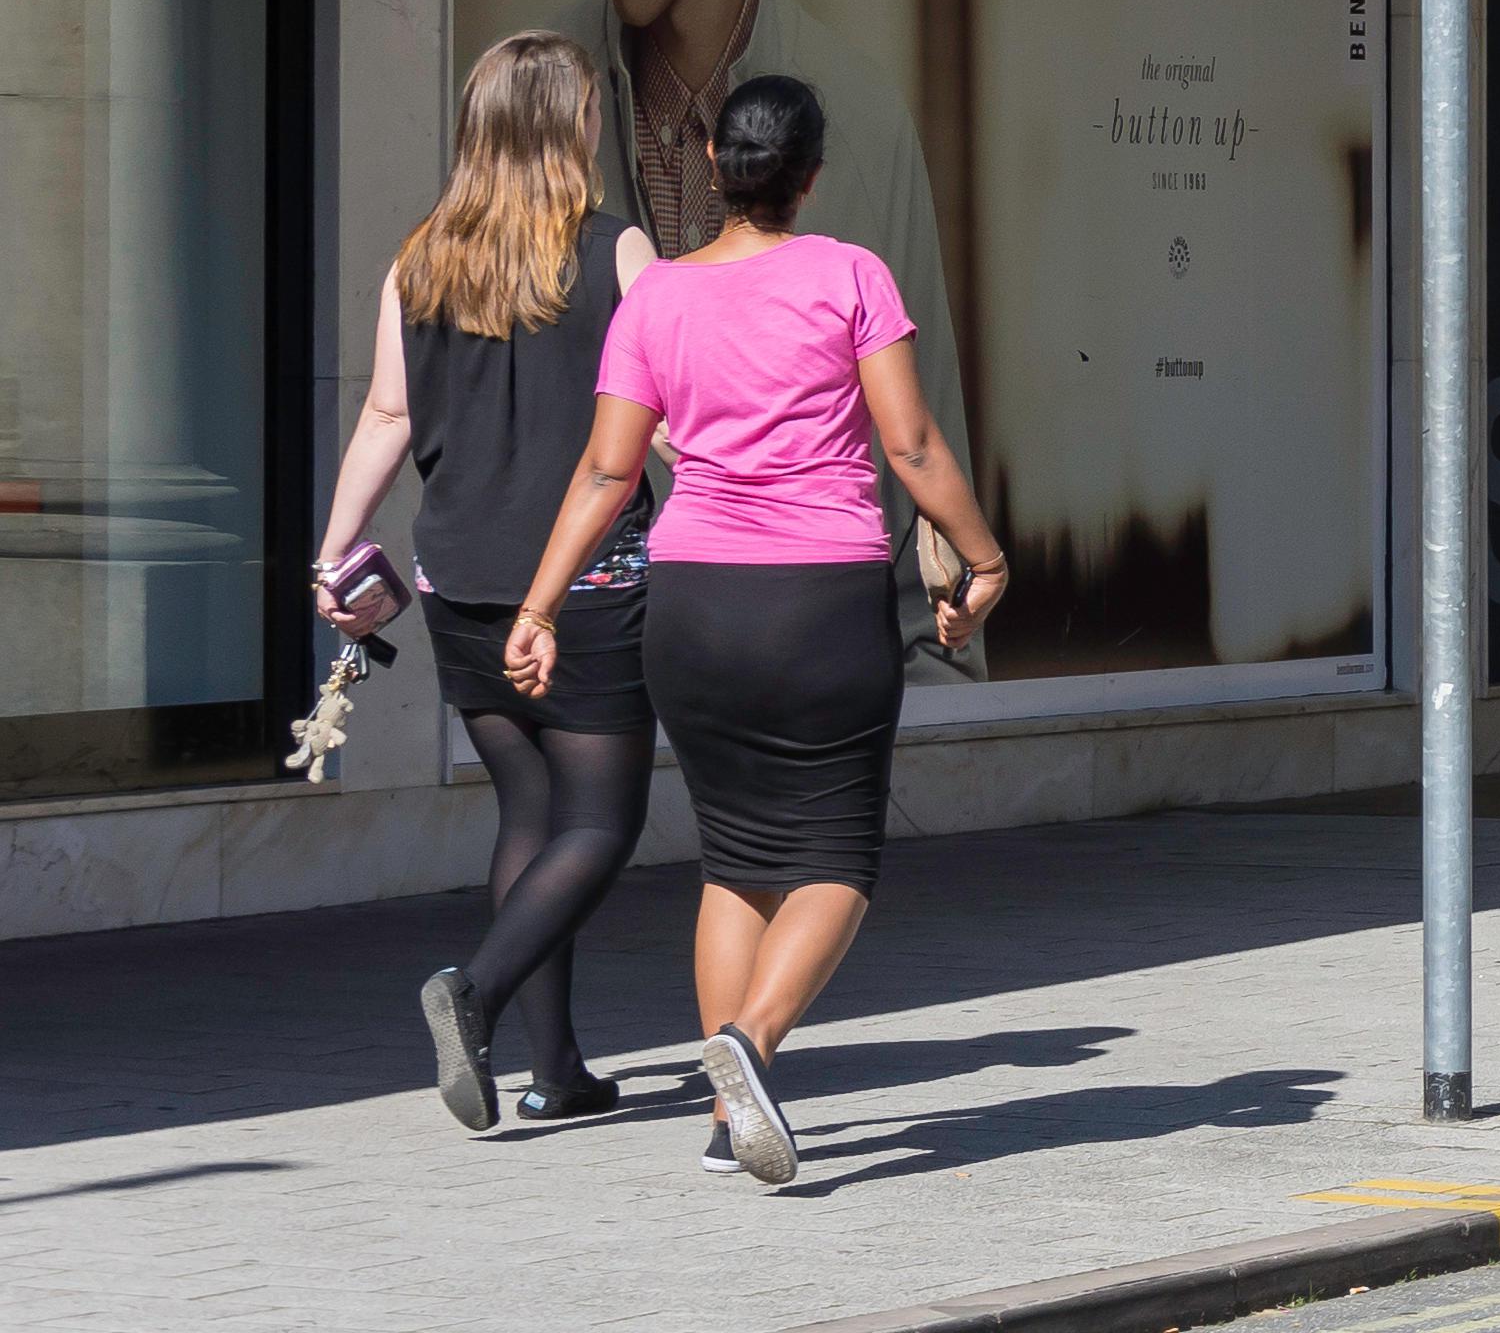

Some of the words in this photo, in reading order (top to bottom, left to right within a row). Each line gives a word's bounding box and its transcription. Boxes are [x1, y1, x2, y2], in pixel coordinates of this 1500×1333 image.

[1141, 53, 1161, 80] the
[1164, 55, 1216, 90] original
[1152, 172, 1178, 190] SINCE
[1183, 173, 1207, 190] 1963
[1155, 356, 1204, 381] #buttonup
